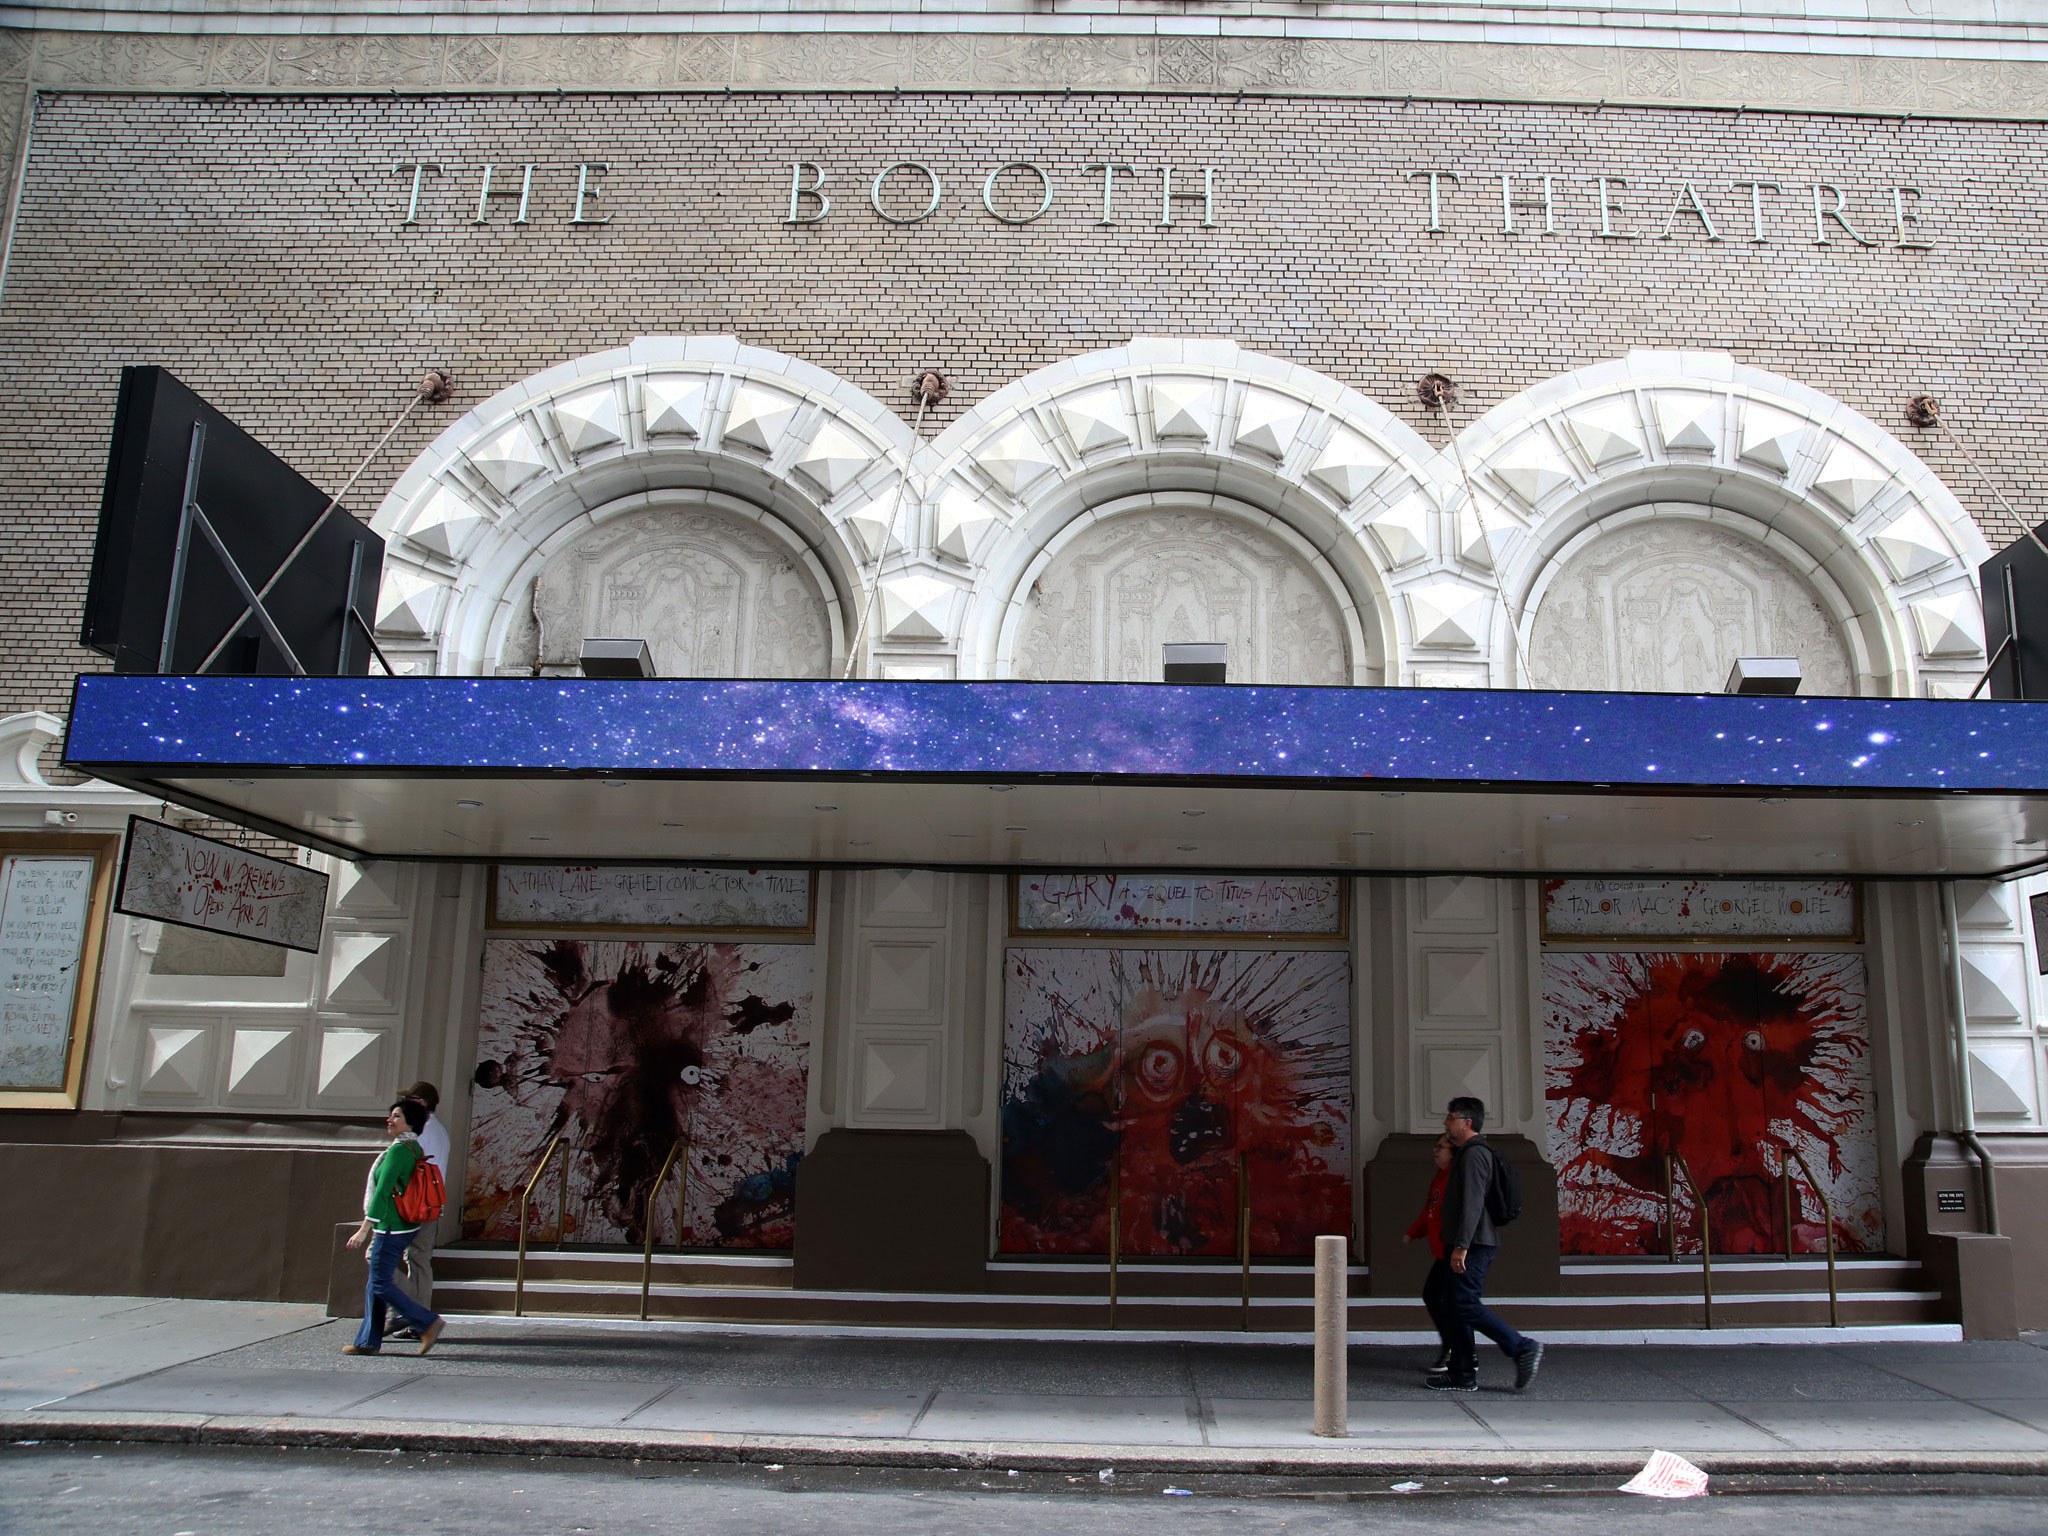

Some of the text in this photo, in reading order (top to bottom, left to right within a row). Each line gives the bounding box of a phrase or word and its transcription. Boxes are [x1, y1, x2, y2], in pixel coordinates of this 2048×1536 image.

[391, 162, 1938, 250] THE BOOTH THEATRE
[185, 848, 286, 893] NOW IN PREVIEWS
[559, 872, 602, 893] LANE
[614, 873, 664, 895] GREATEST
[667, 874, 706, 893] COMIC
[708, 875, 748, 894] ACTOR
[194, 885, 268, 928] OPENS APRIL 21
[1043, 872, 1118, 911] GARY
[1140, 884, 1192, 902] SEQUEL
[1194, 886, 1213, 900] TO
[1217, 880, 1252, 902] TITUS
[1256, 880, 1330, 906] ANDRONICUS
[1568, 894, 1670, 917] TAYLOR MAC
[1702, 897, 1760, 917] GEORGE
[1778, 895, 1831, 916] WOLFE
